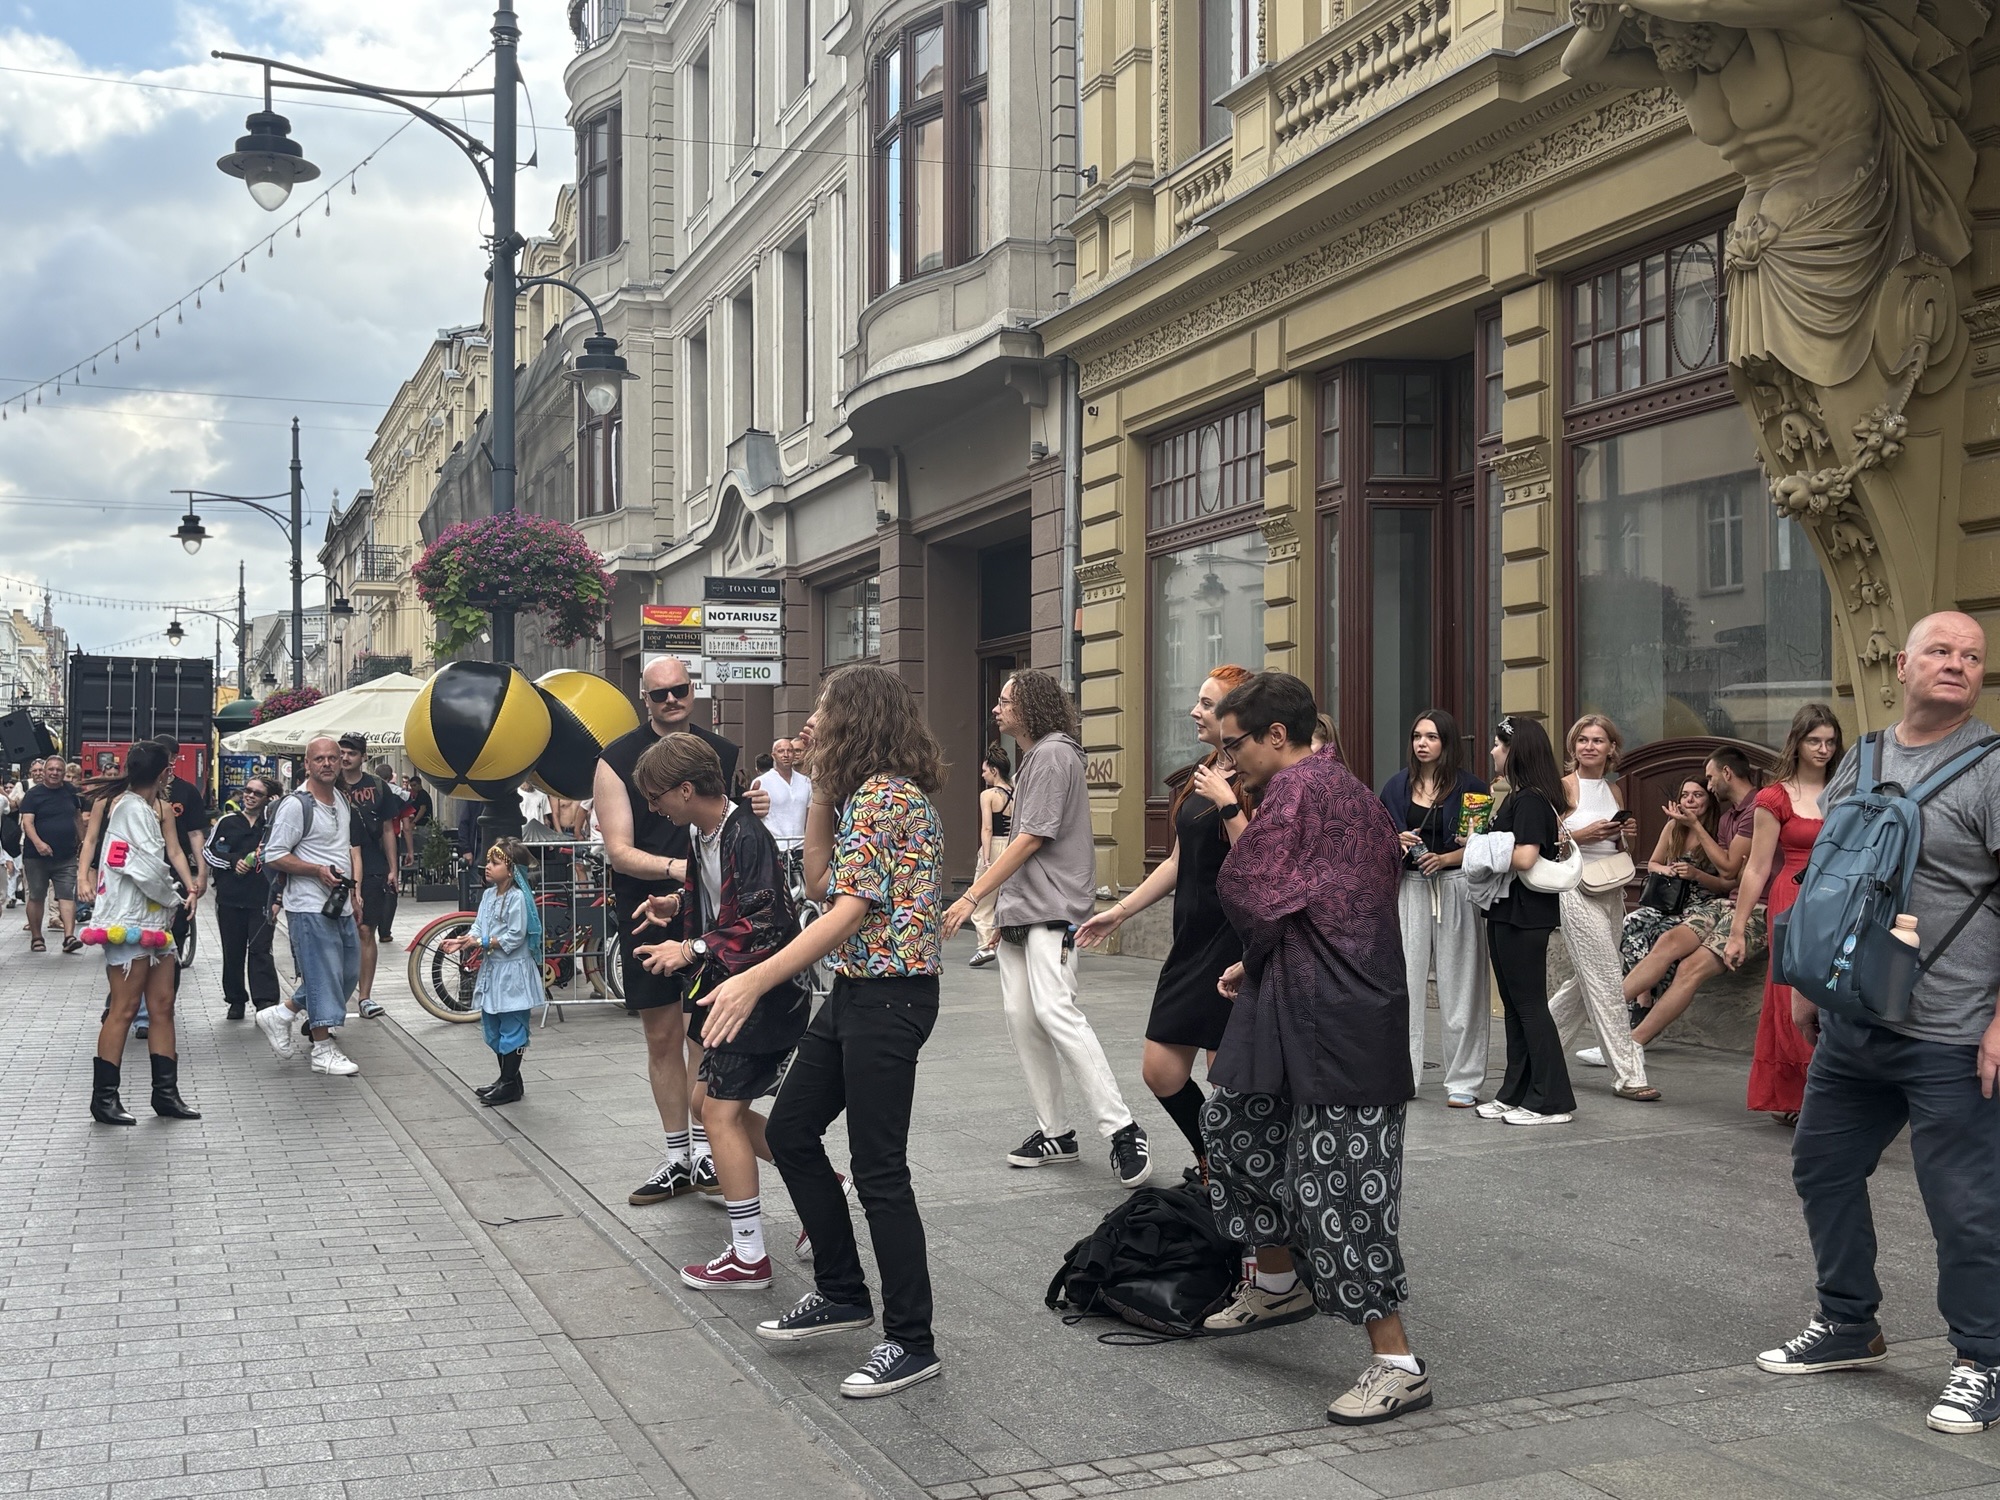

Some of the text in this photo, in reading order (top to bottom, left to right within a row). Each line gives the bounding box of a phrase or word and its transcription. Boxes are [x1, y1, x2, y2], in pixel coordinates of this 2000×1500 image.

[728, 585, 758, 593] TOAST
[761, 586, 776, 594] CLUB
[708, 612, 777, 622] NOTARIUSZ
[665, 632, 701, 640] APARTHOT
[107, 841, 130, 868] E
